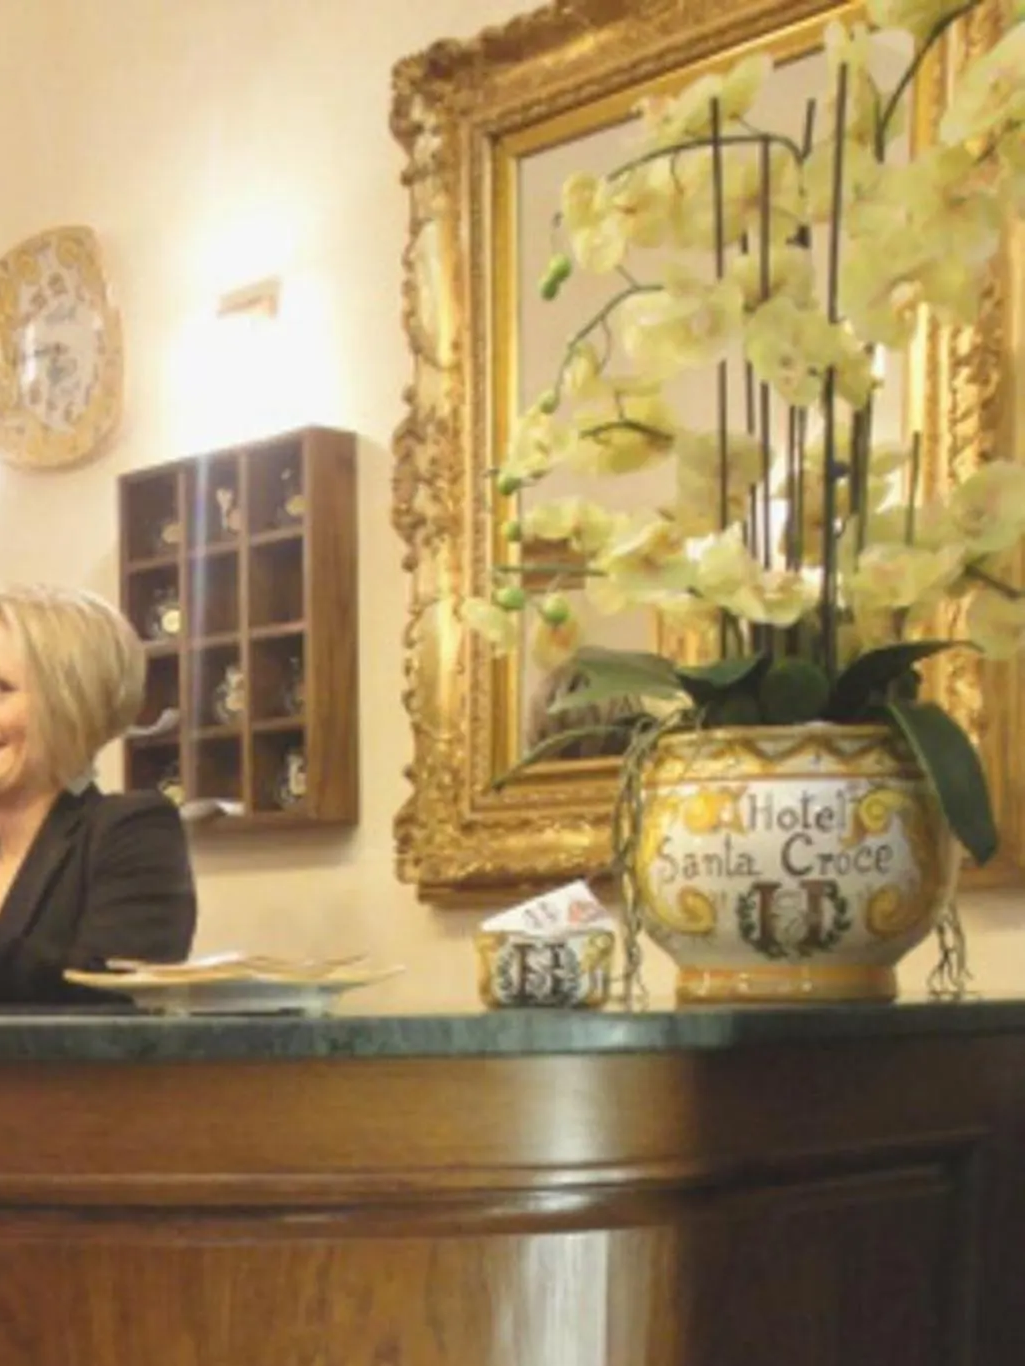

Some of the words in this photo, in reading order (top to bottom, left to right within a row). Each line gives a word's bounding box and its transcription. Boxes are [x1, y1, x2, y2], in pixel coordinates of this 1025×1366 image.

[748, 790, 848, 833] Hotel
[658, 834, 762, 882] Santa
[780, 832, 893, 877] Croce
